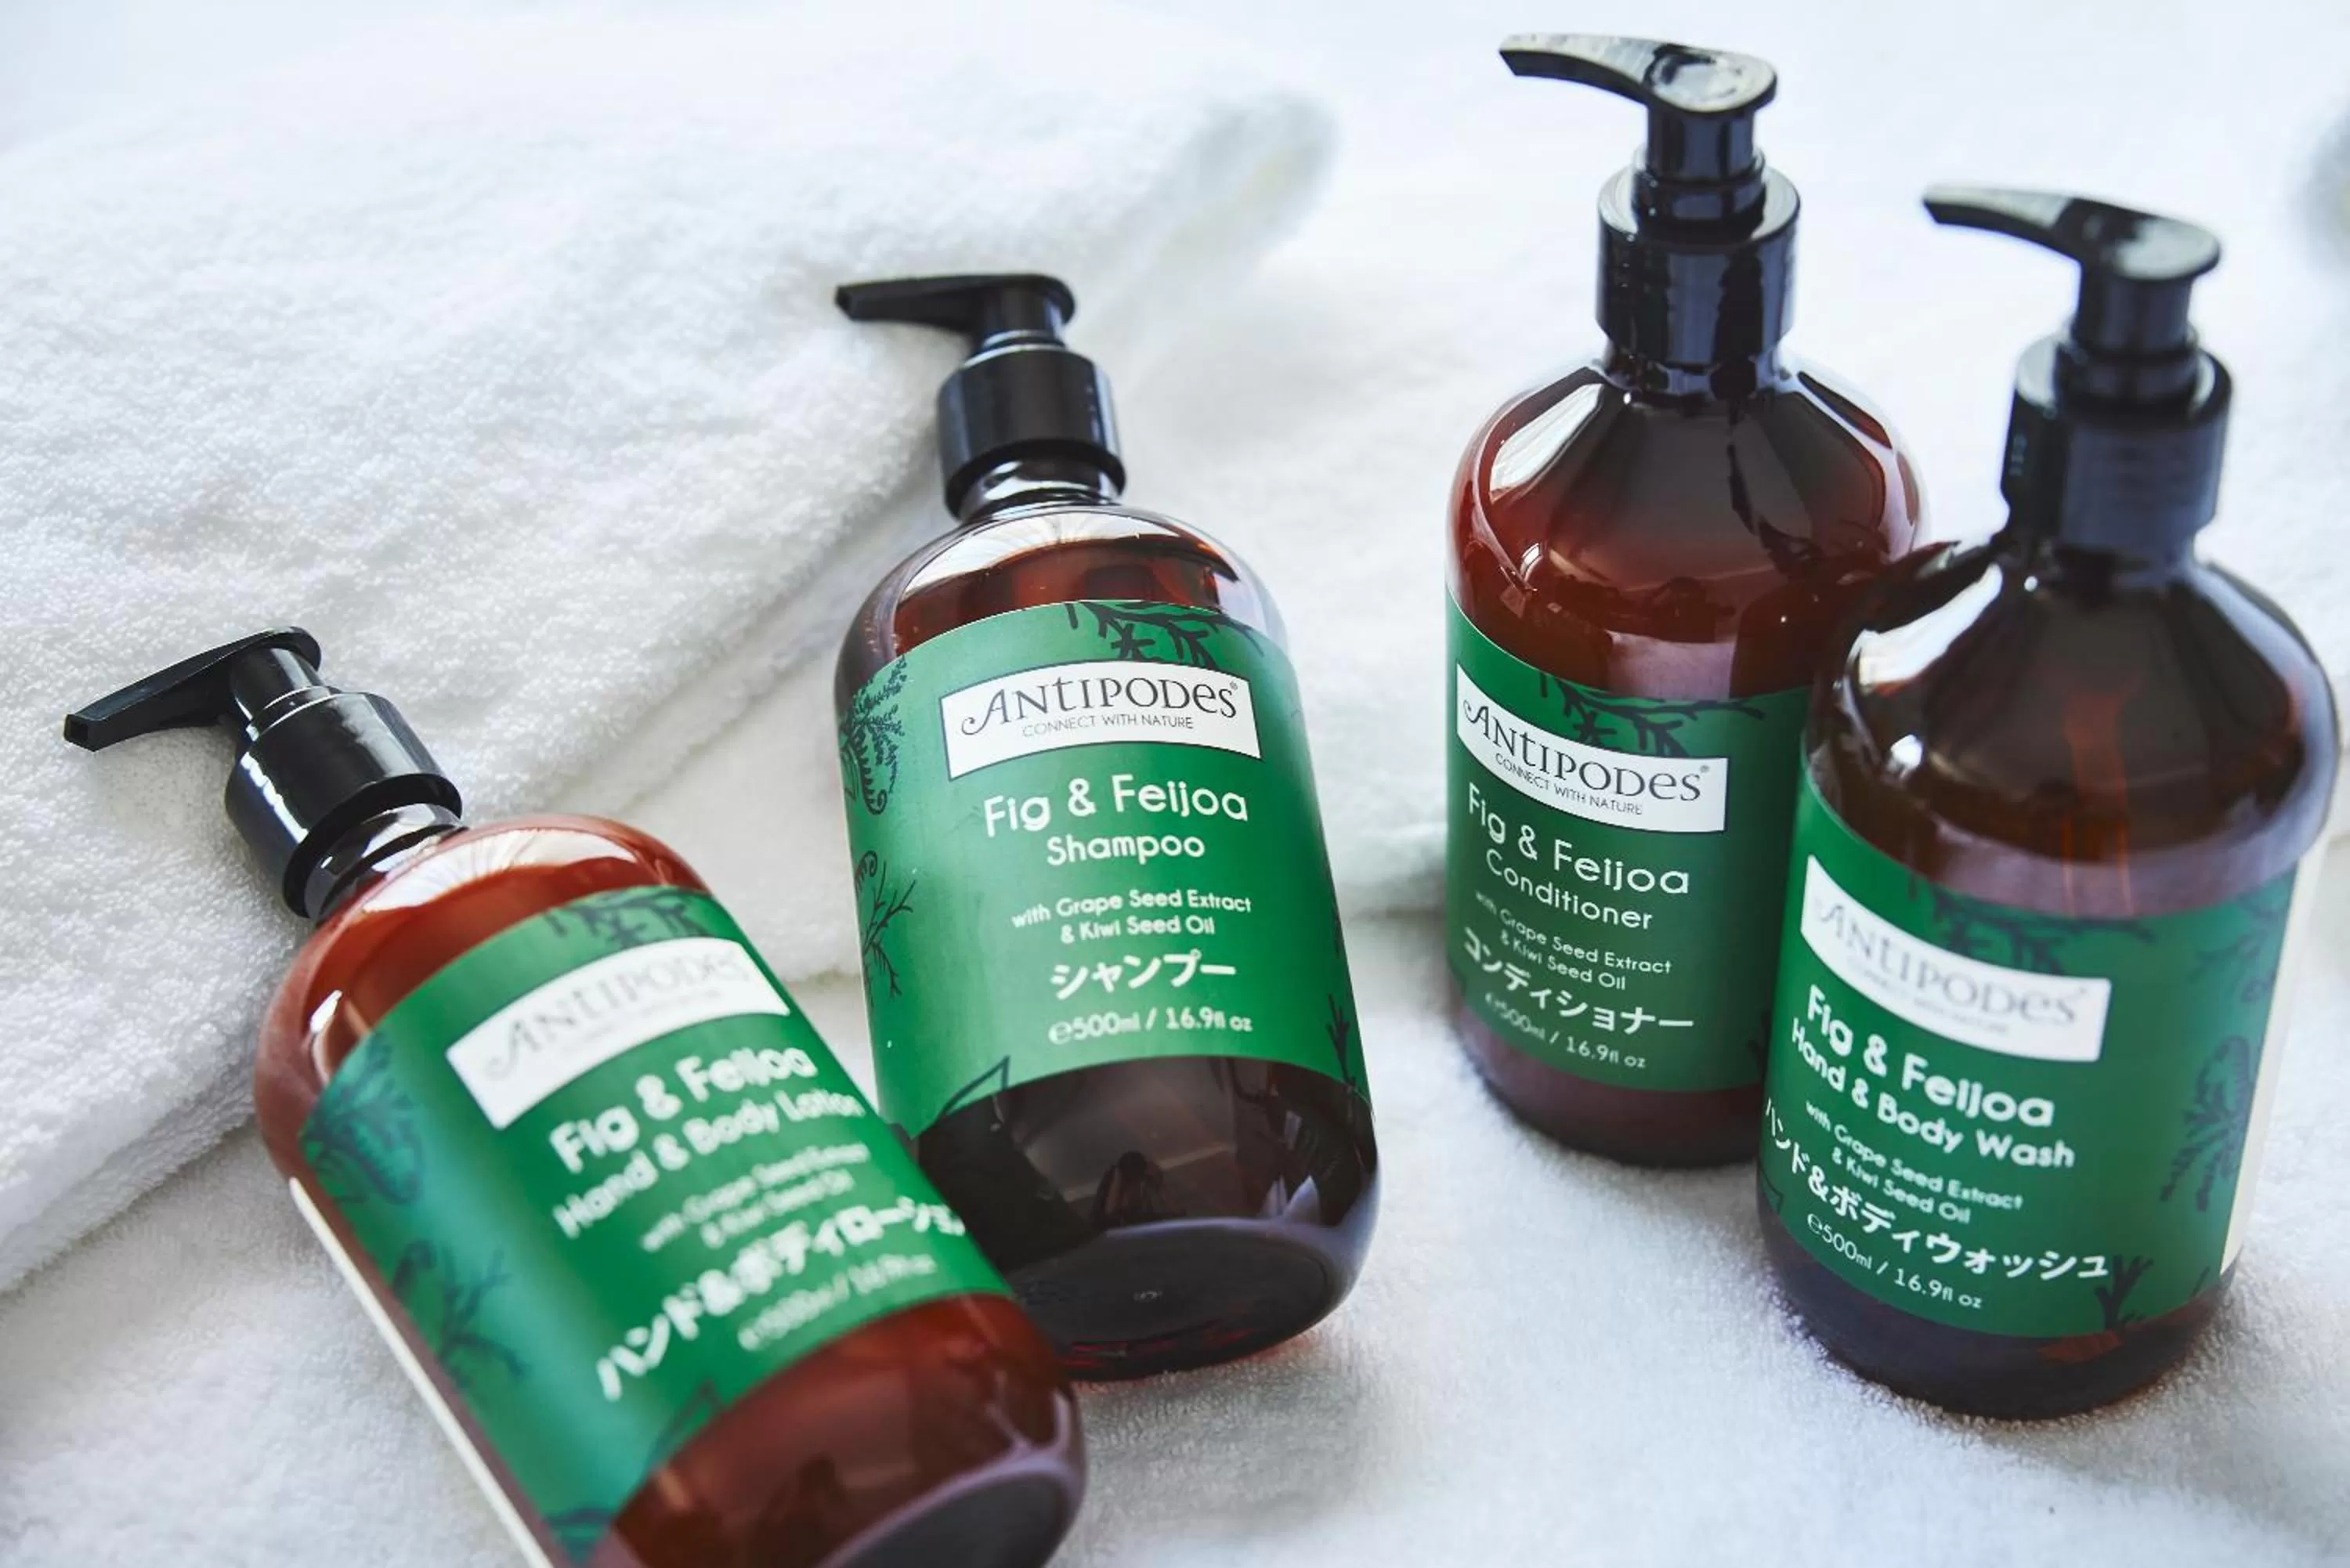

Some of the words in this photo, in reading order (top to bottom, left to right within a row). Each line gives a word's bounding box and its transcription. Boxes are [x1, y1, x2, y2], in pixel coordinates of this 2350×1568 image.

[1022, 715, 1097, 737] CONNECT
[1101, 714, 1138, 728] WITH
[1141, 714, 1195, 729] NATURE
[983, 794, 1051, 837] Fig
[1067, 777, 1097, 817] &
[1111, 773, 1249, 822] Feijoa
[1495, 752, 1549, 792] CONNECT
[1553, 784, 1587, 804] WITH
[1589, 790, 1643, 815] NATURE
[1047, 833, 1206, 865] Shampoo
[1468, 782, 1506, 844] Fig
[1517, 824, 1538, 861] &
[1553, 839, 1690, 894] Feijoa
[1011, 902, 1051, 928] with
[1056, 894, 1123, 917] Grape
[1128, 888, 1184, 909] Seed
[1186, 888, 1253, 912] Extract
[1486, 848, 1654, 930] Conditioner
[1061, 924, 1076, 944] &
[1079, 919, 1121, 941] Kiwi
[1126, 915, 1181, 935] Seed
[1185, 915, 1216, 936] Oil
[1499, 908, 1548, 945] Grape
[1552, 936, 1599, 963] Seed
[1603, 952, 1672, 974] Extract
[1050, 948, 1237, 1000] シャンプー
[1462, 927, 1694, 1035] コンディショナー
[1513, 938, 1544, 965] Kiwi
[1547, 955, 1593, 983] Seed
[1597, 972, 1626, 991] Oil
[1145, 1006, 1158, 1031] /
[1229, 1015, 1253, 1032] oz
[1623, 1055, 1647, 1069] oz
[1807, 983, 1854, 1057] Fig
[1863, 1033, 1888, 1078] &
[1901, 1053, 2055, 1128] Feijoa
[549, 1104, 640, 1174] Fig
[634, 1073, 683, 1121] &
[1791, 1017, 1846, 1093] Hand
[1851, 1077, 1869, 1110] &
[1877, 1092, 1965, 1154] Body
[1975, 1128, 2075, 1169] Wash
[652, 1133, 690, 1171] &
[1806, 1100, 1831, 1132] with
[1833, 1122, 1887, 1169] Grape
[1890, 1157, 1943, 1194] Seed
[1947, 1178, 2023, 1210] Extract
[1831, 1146, 1843, 1166] &
[1845, 1154, 1878, 1189] Kiwi
[1882, 1178, 1935, 1214] Seed
[1938, 1201, 1972, 1224] Oil
[1876, 1260, 1889, 1276] /
[1958, 1292, 1984, 1310] oz
